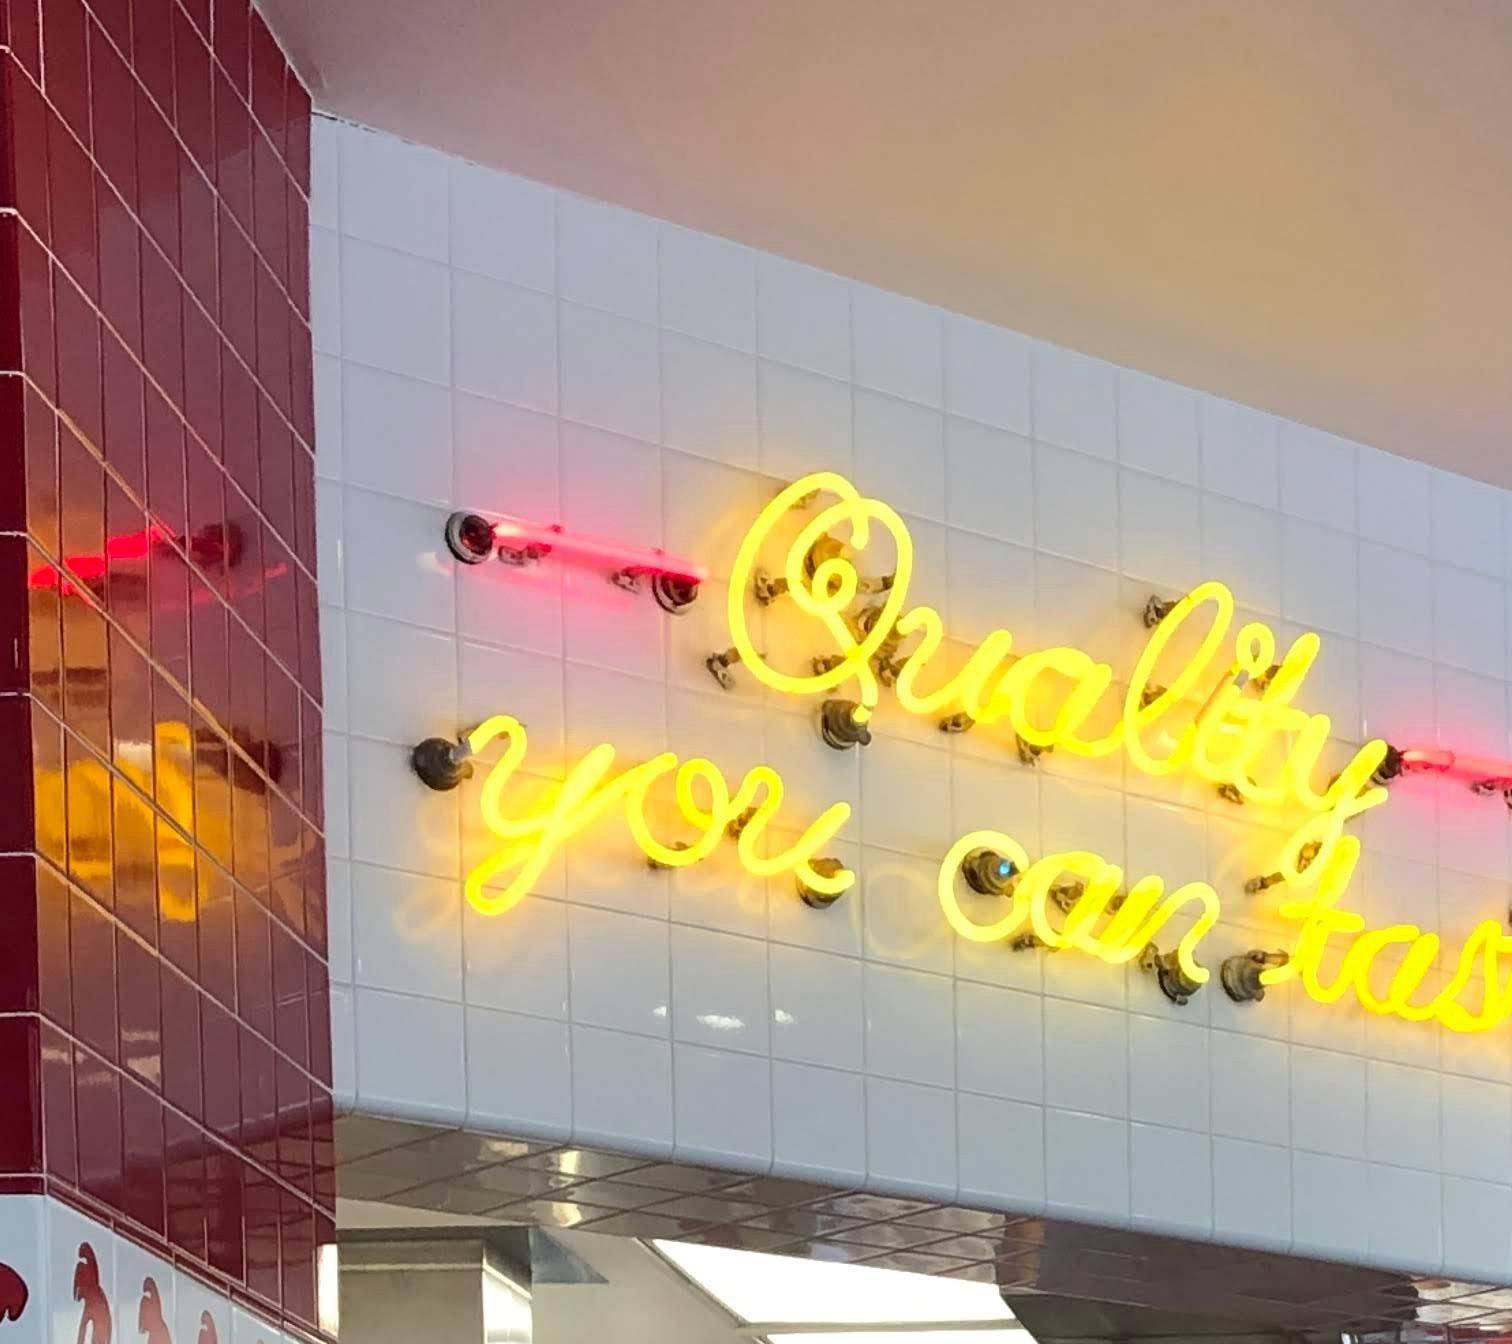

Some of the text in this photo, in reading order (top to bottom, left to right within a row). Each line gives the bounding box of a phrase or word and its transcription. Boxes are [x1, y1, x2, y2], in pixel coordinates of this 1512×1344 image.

[464, 715, 856, 917] you
[938, 830, 1221, 984] can
[727, 471, 1389, 888] Quality
